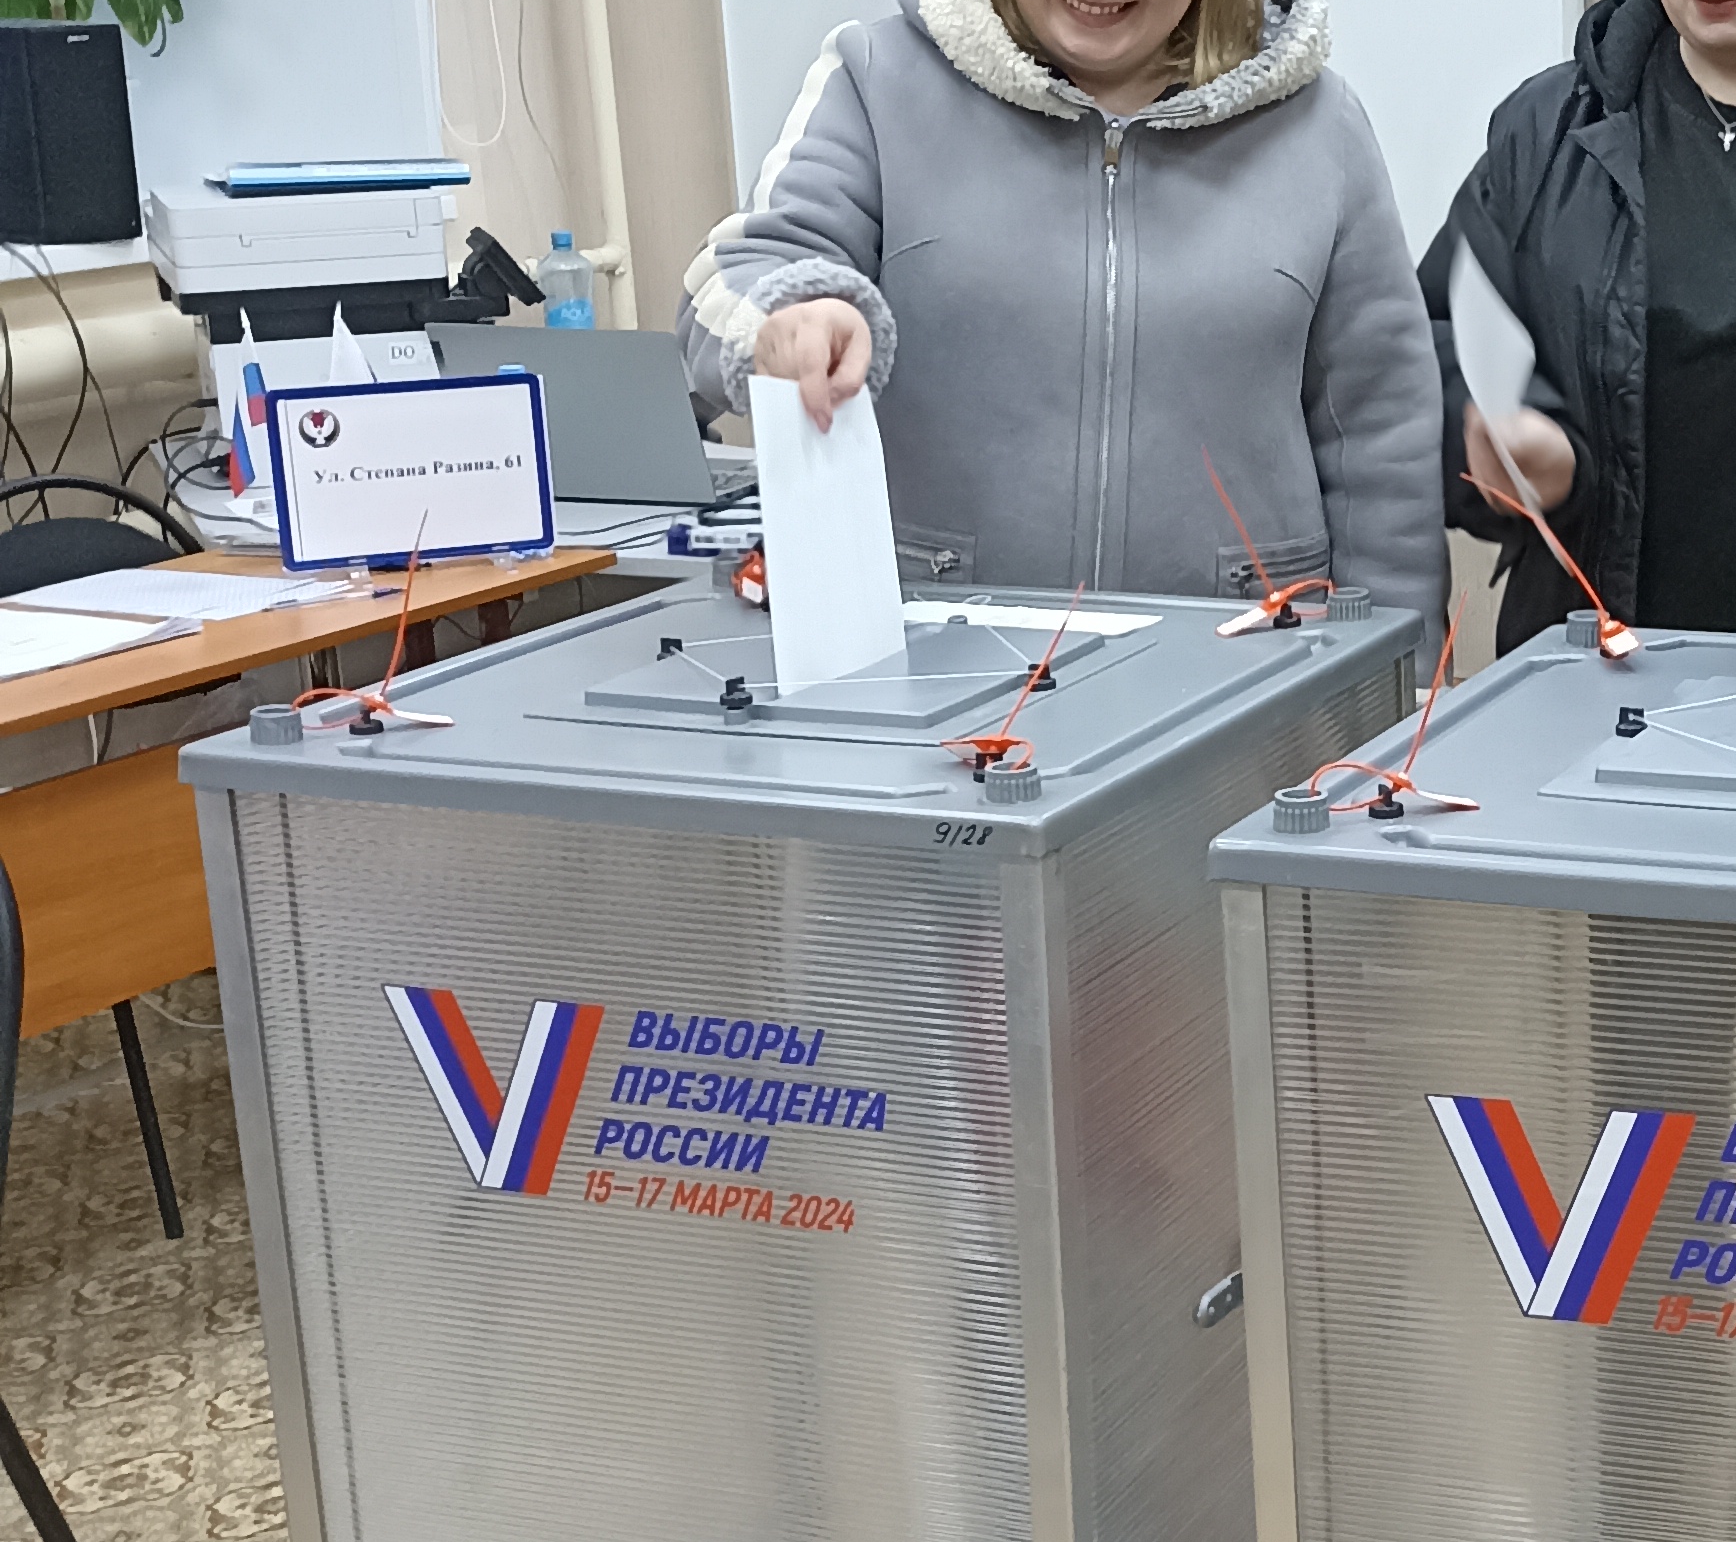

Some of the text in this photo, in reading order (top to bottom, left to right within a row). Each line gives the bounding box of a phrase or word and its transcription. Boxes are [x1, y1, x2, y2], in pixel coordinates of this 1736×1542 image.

[313, 454, 523, 484] Ул. Степана Разина, 61
[932, 821, 993, 847] 9/28
[628, 1010, 824, 1067] ВЫБОРЫ
[610, 1065, 887, 1132] ПРЕЗИДЕНТА
[594, 1118, 770, 1173] РОССИИ
[671, 1180, 774, 1224] МАРТА
[780, 1194, 855, 1233] 2024
